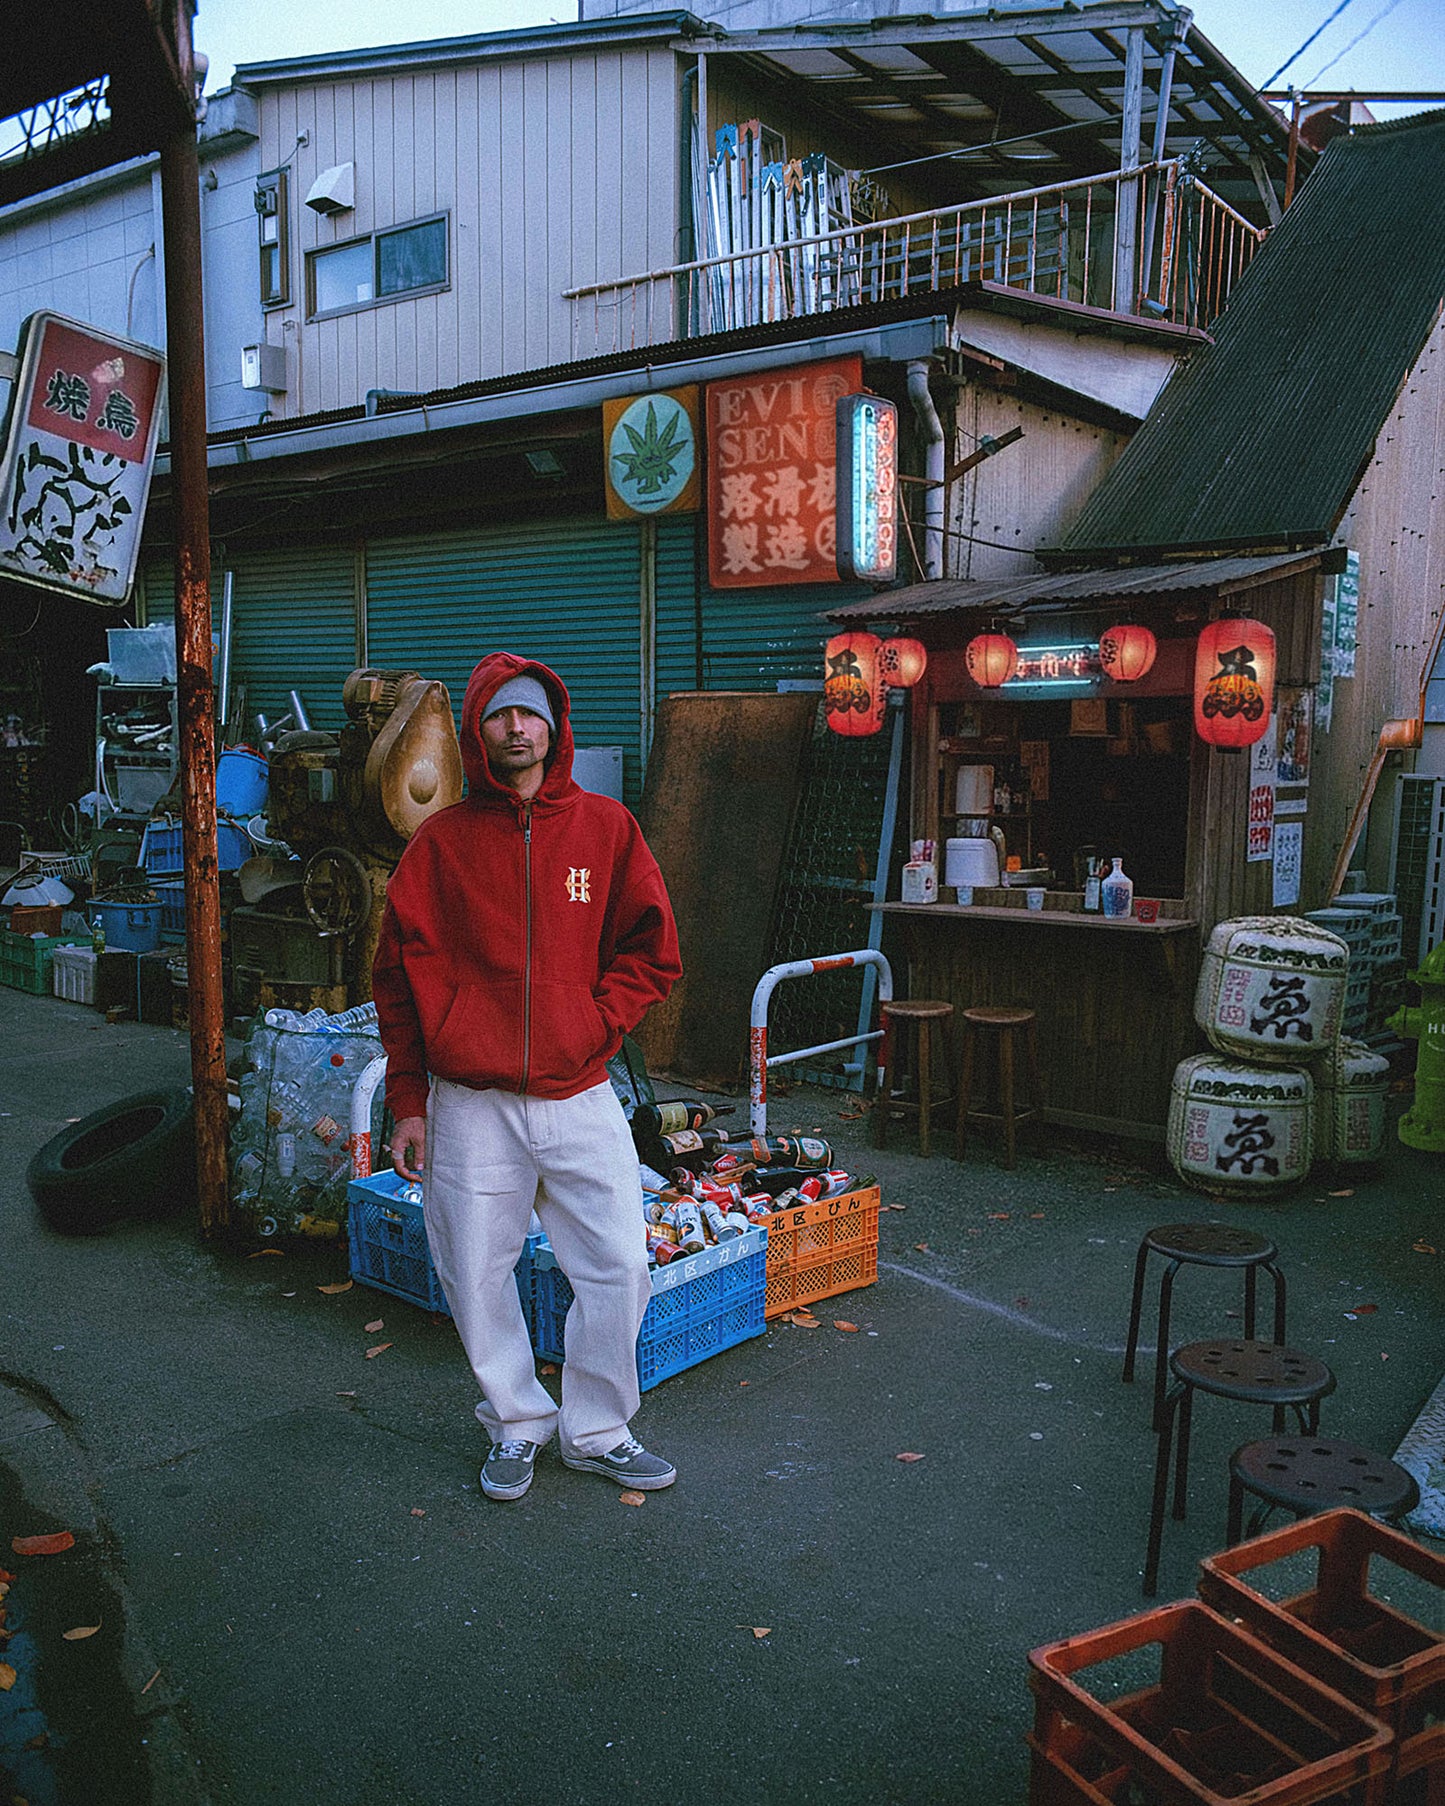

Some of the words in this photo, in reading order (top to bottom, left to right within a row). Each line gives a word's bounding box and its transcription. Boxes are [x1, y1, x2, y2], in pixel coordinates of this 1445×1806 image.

[771, 1198, 861, 1232] 北区・びん
[663, 1243, 750, 1287] 北区・かん
